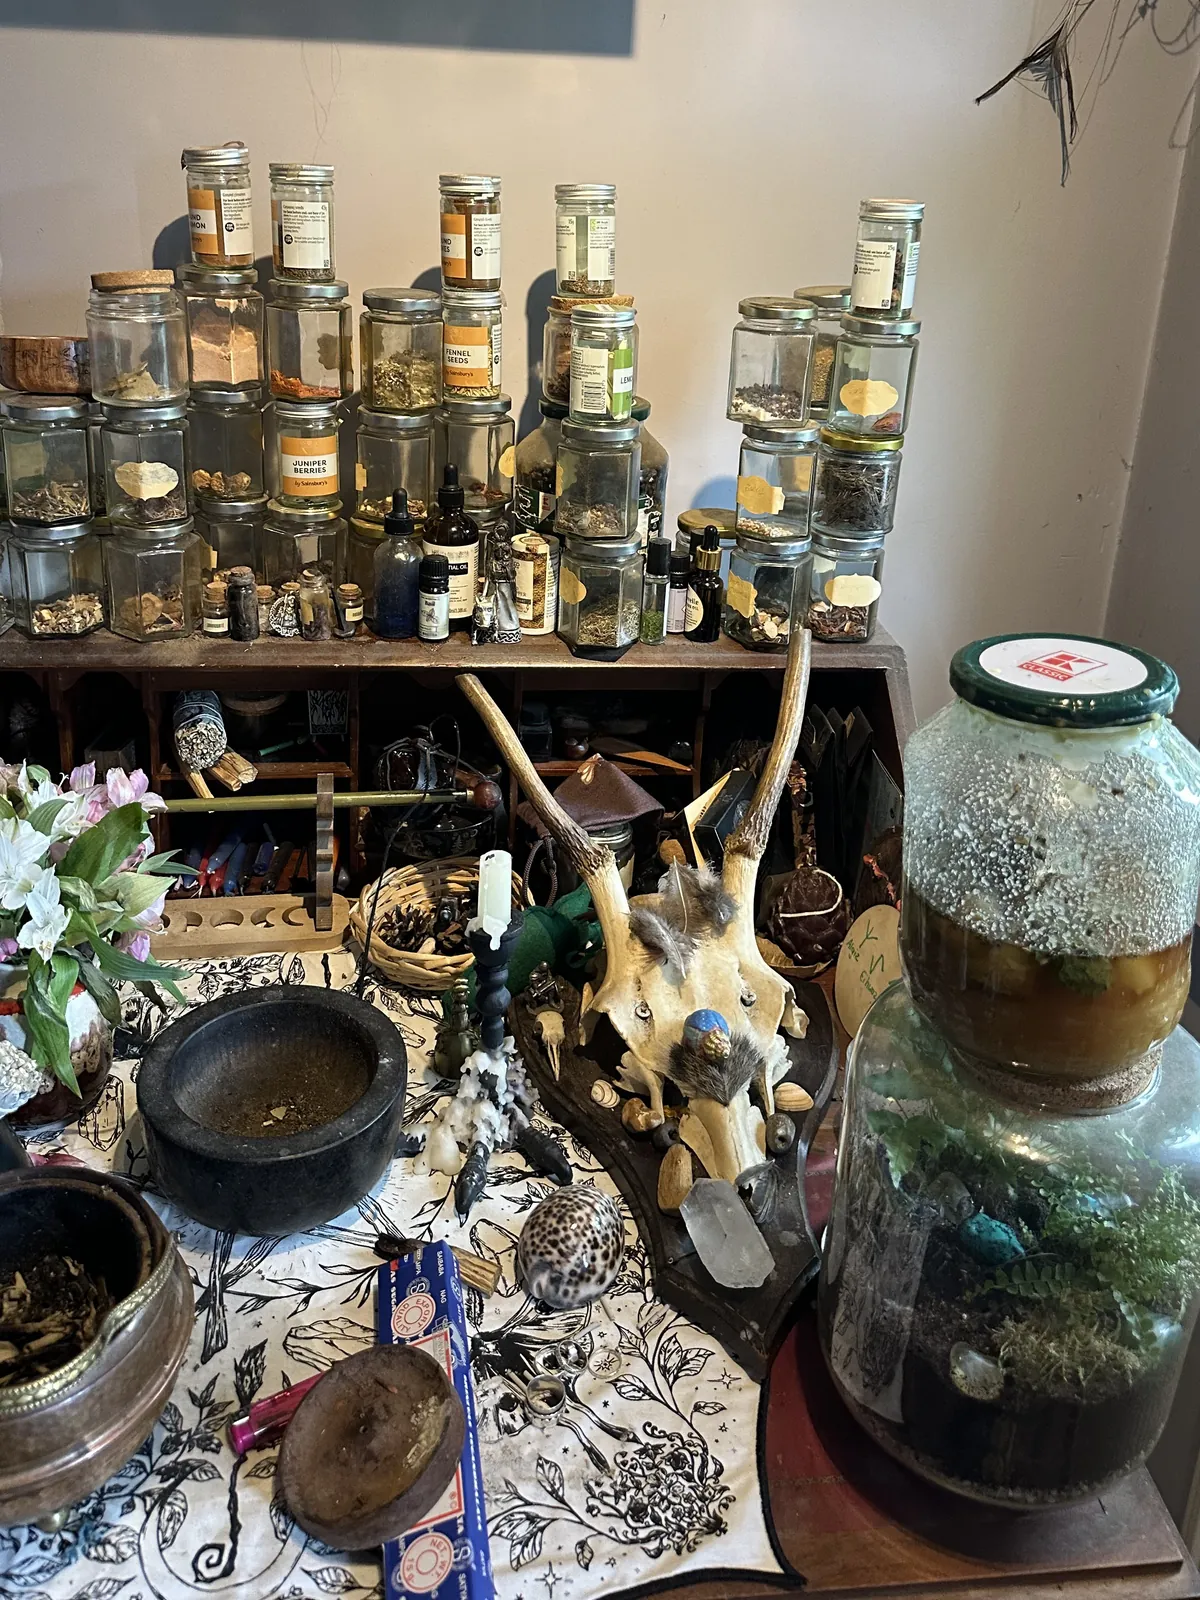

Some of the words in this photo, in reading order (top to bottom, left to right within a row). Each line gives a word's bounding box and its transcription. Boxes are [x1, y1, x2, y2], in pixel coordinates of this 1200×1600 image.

[445, 348, 472, 357] FENNEL
[447, 356, 469, 364] SEEDS
[1022, 663, 1069, 681] CLASSIC
[396, 1303, 411, 1332] QUALITY
[416, 1299, 430, 1328] EXPORT
